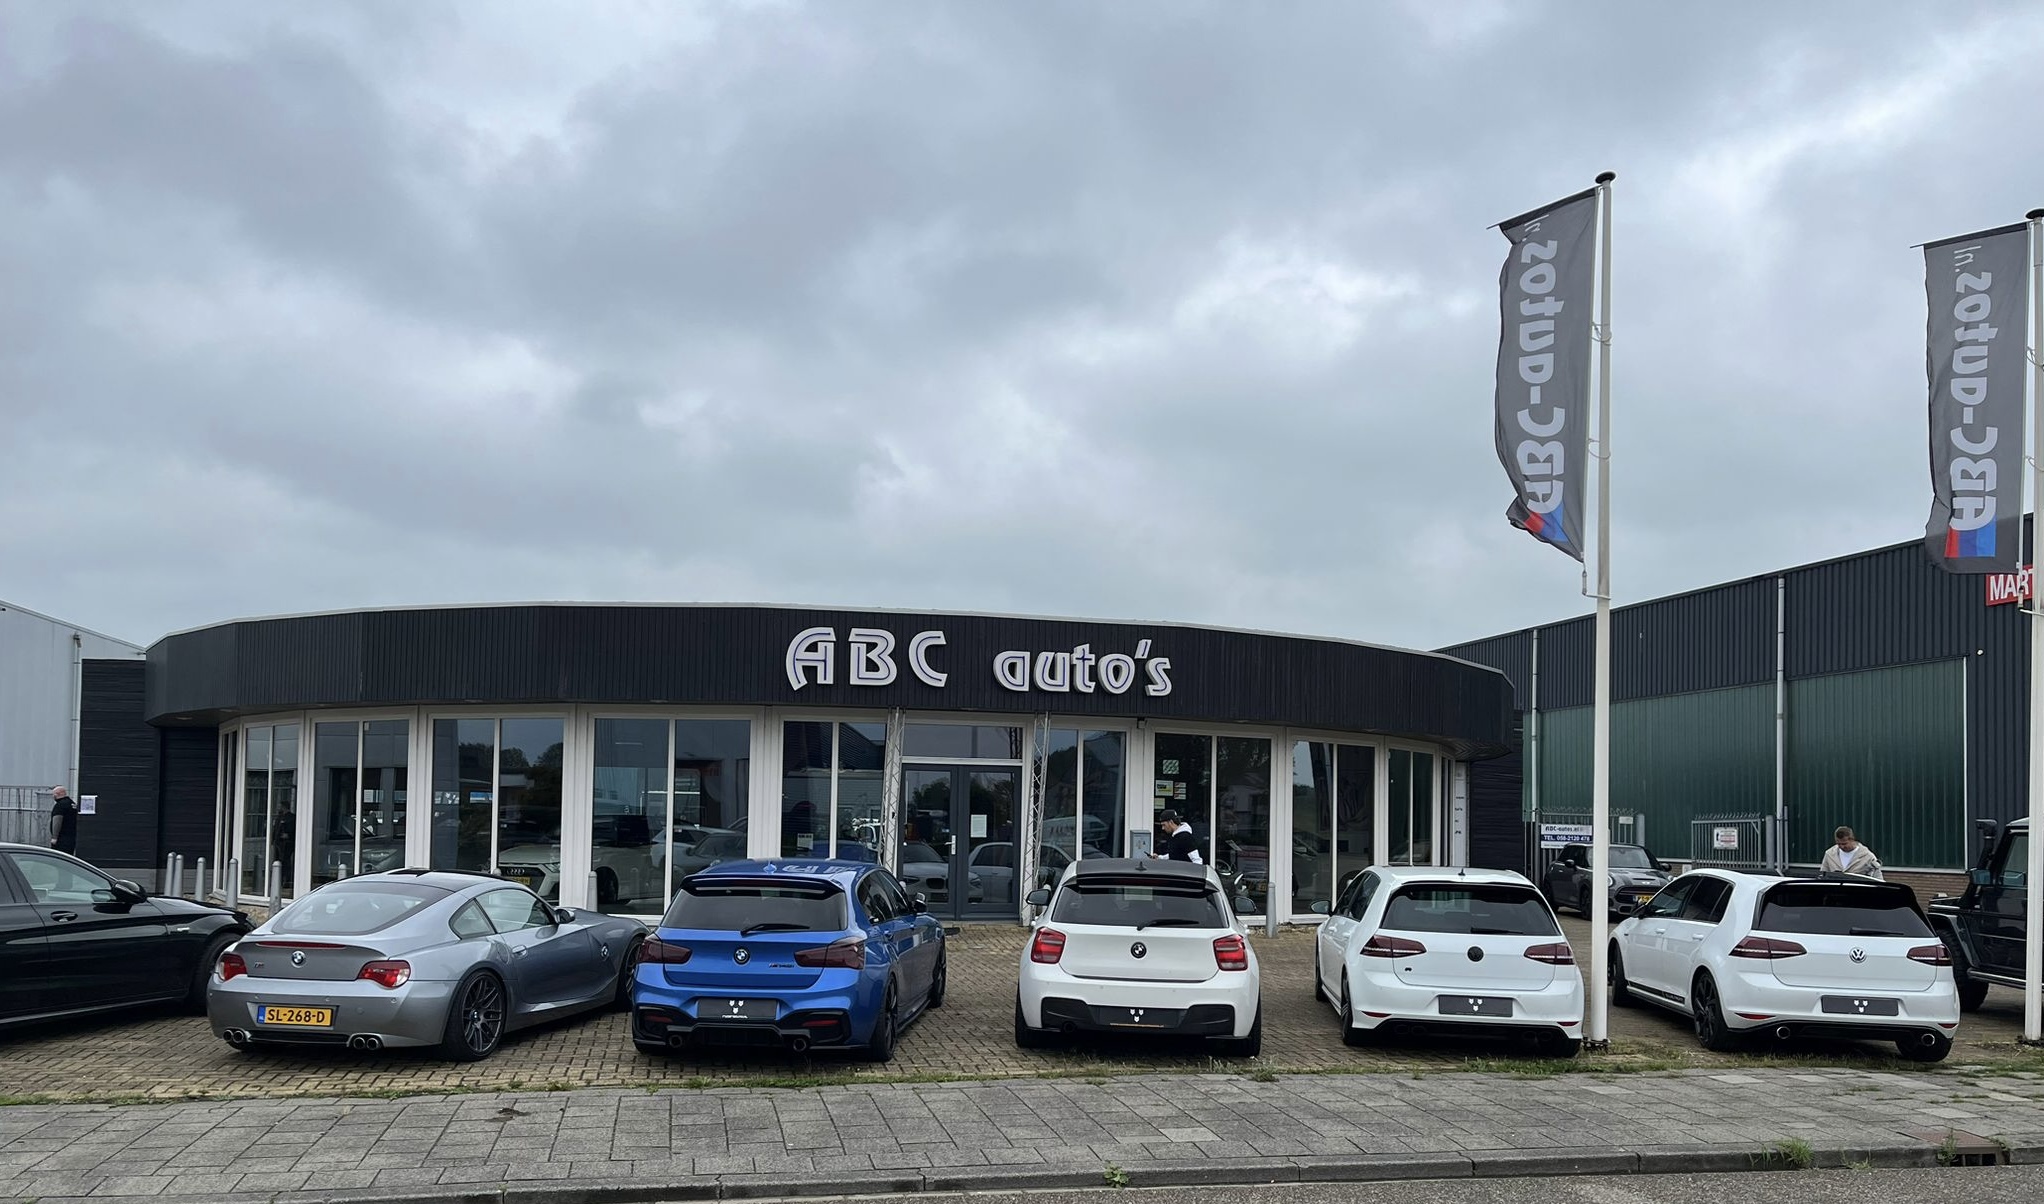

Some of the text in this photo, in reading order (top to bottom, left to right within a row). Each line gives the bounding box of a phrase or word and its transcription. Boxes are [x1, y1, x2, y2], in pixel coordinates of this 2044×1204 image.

[785, 626, 1172, 697] ABC auto's
[267, 1009, 325, 1023] SL-268-D
